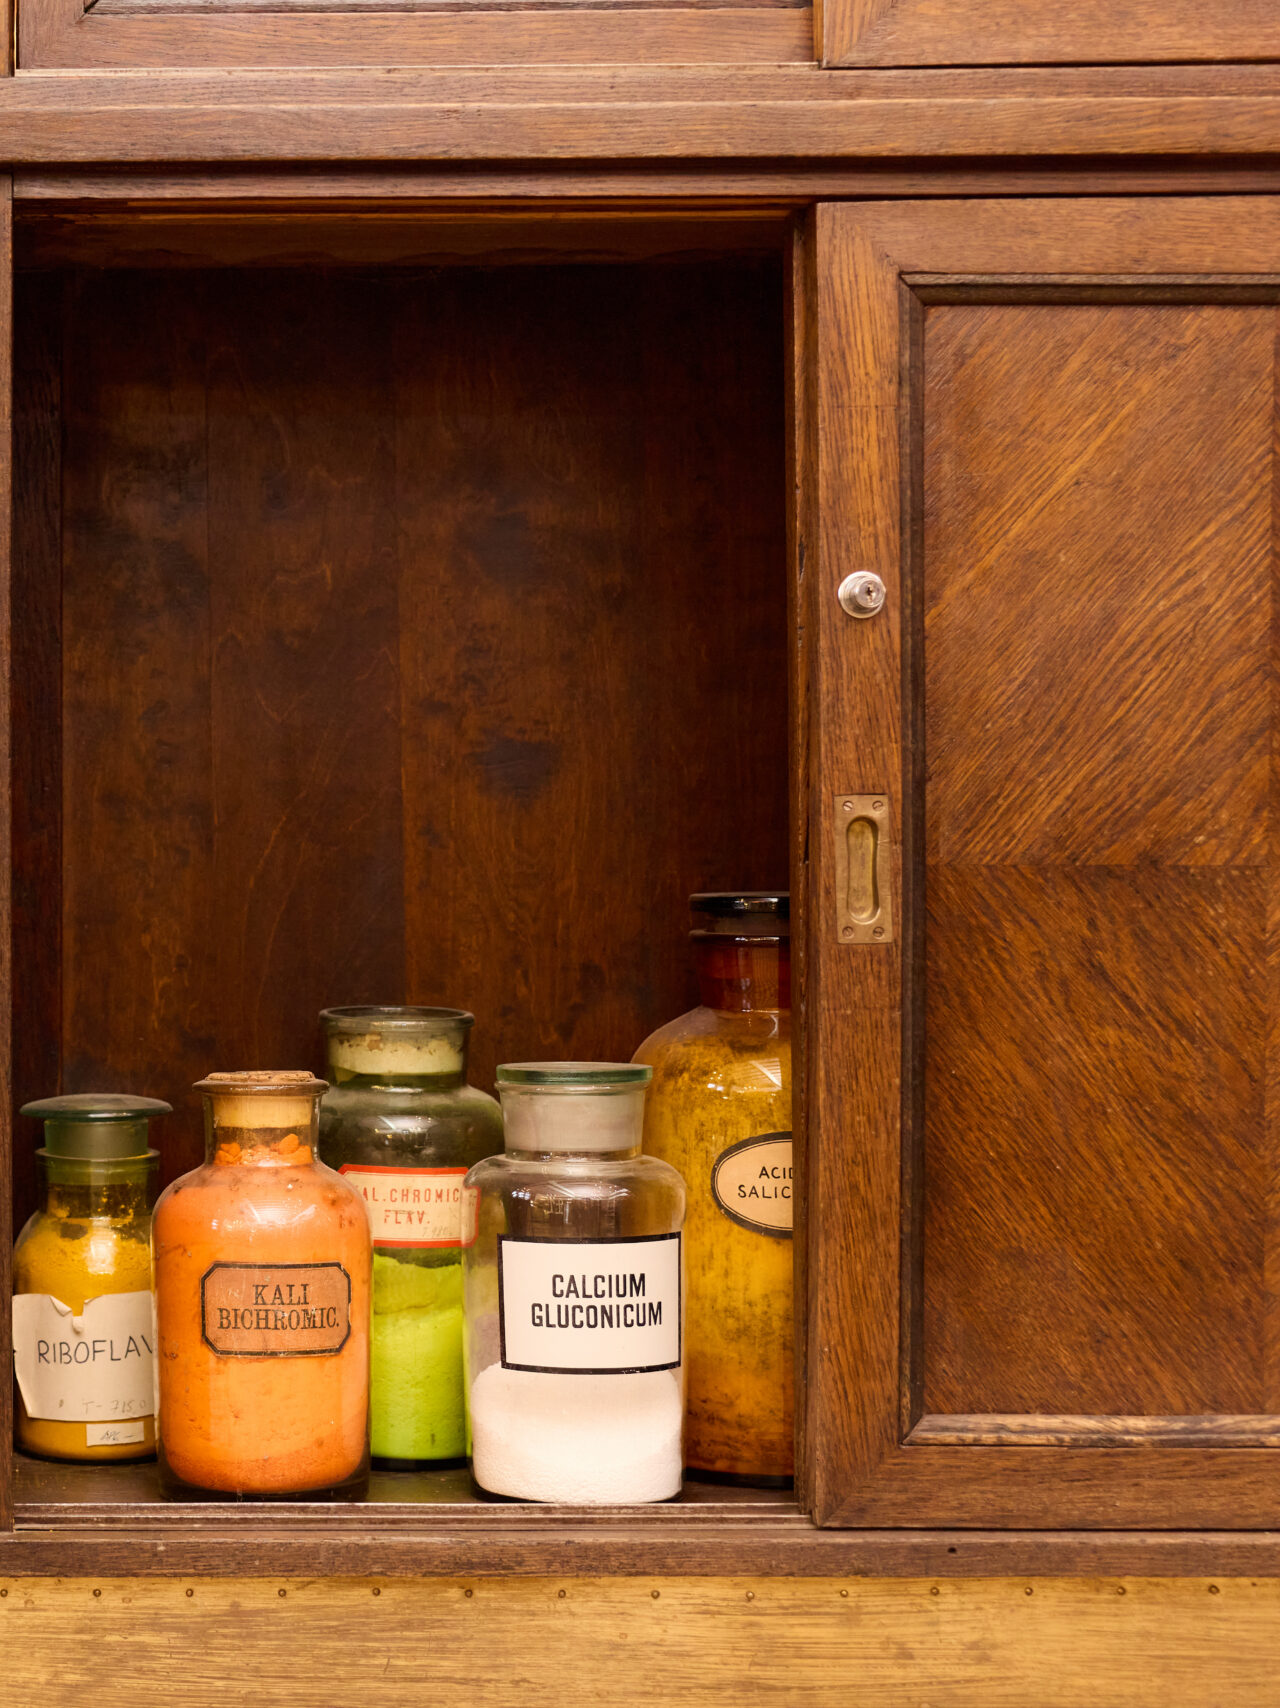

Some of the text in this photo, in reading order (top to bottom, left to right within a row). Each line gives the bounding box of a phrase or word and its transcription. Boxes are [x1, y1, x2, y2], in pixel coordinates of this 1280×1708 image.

[352, 1185, 460, 1204] AL.CHROMIC
[737, 1184, 792, 1199] SALIC
[383, 1208, 431, 1225] FLAV.
[252, 1283, 310, 1306] KALI
[551, 1272, 646, 1299] CALCIUM
[216, 1305, 340, 1331] BICHROMIC.
[530, 1300, 663, 1329] GLUCONICUM
